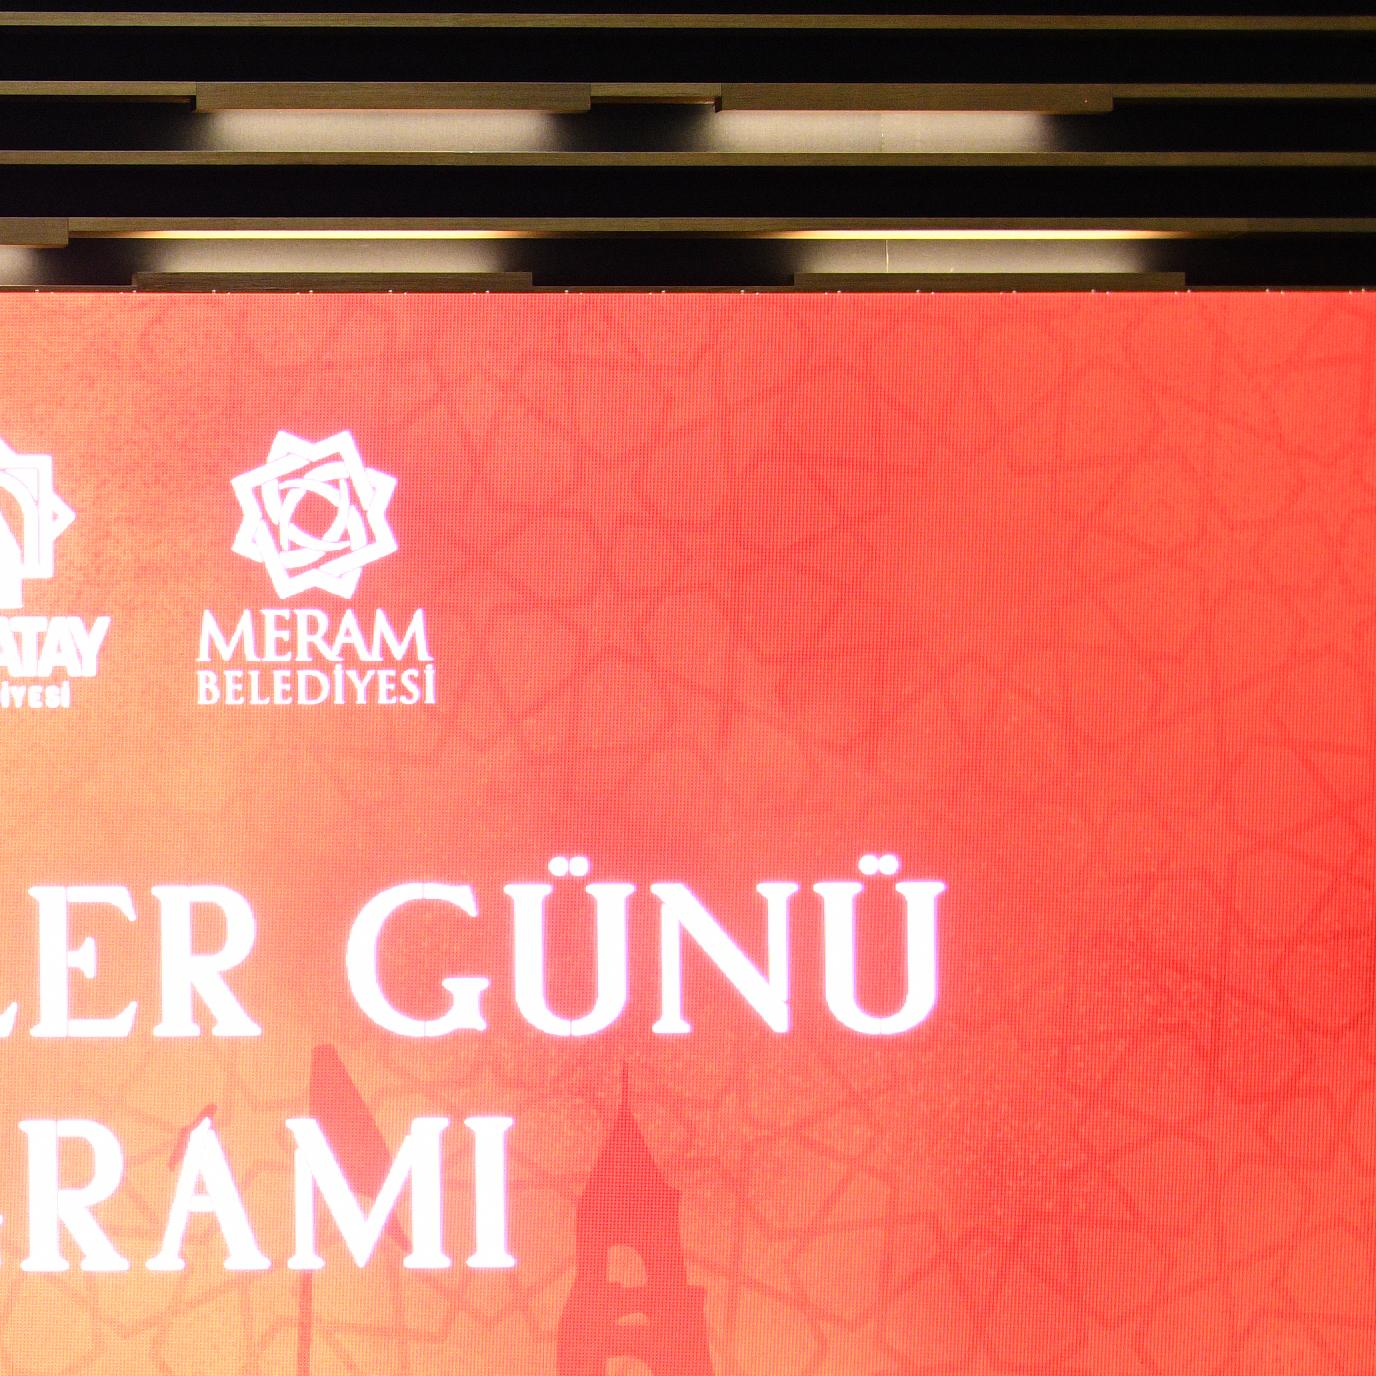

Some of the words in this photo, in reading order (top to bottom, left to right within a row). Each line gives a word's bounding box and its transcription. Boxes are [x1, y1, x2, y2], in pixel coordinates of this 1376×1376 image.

[196, 608, 434, 662] MERAM
[196, 664, 436, 705] BELEDİYESİ
[345, 854, 945, 1039] GÜNÜ
